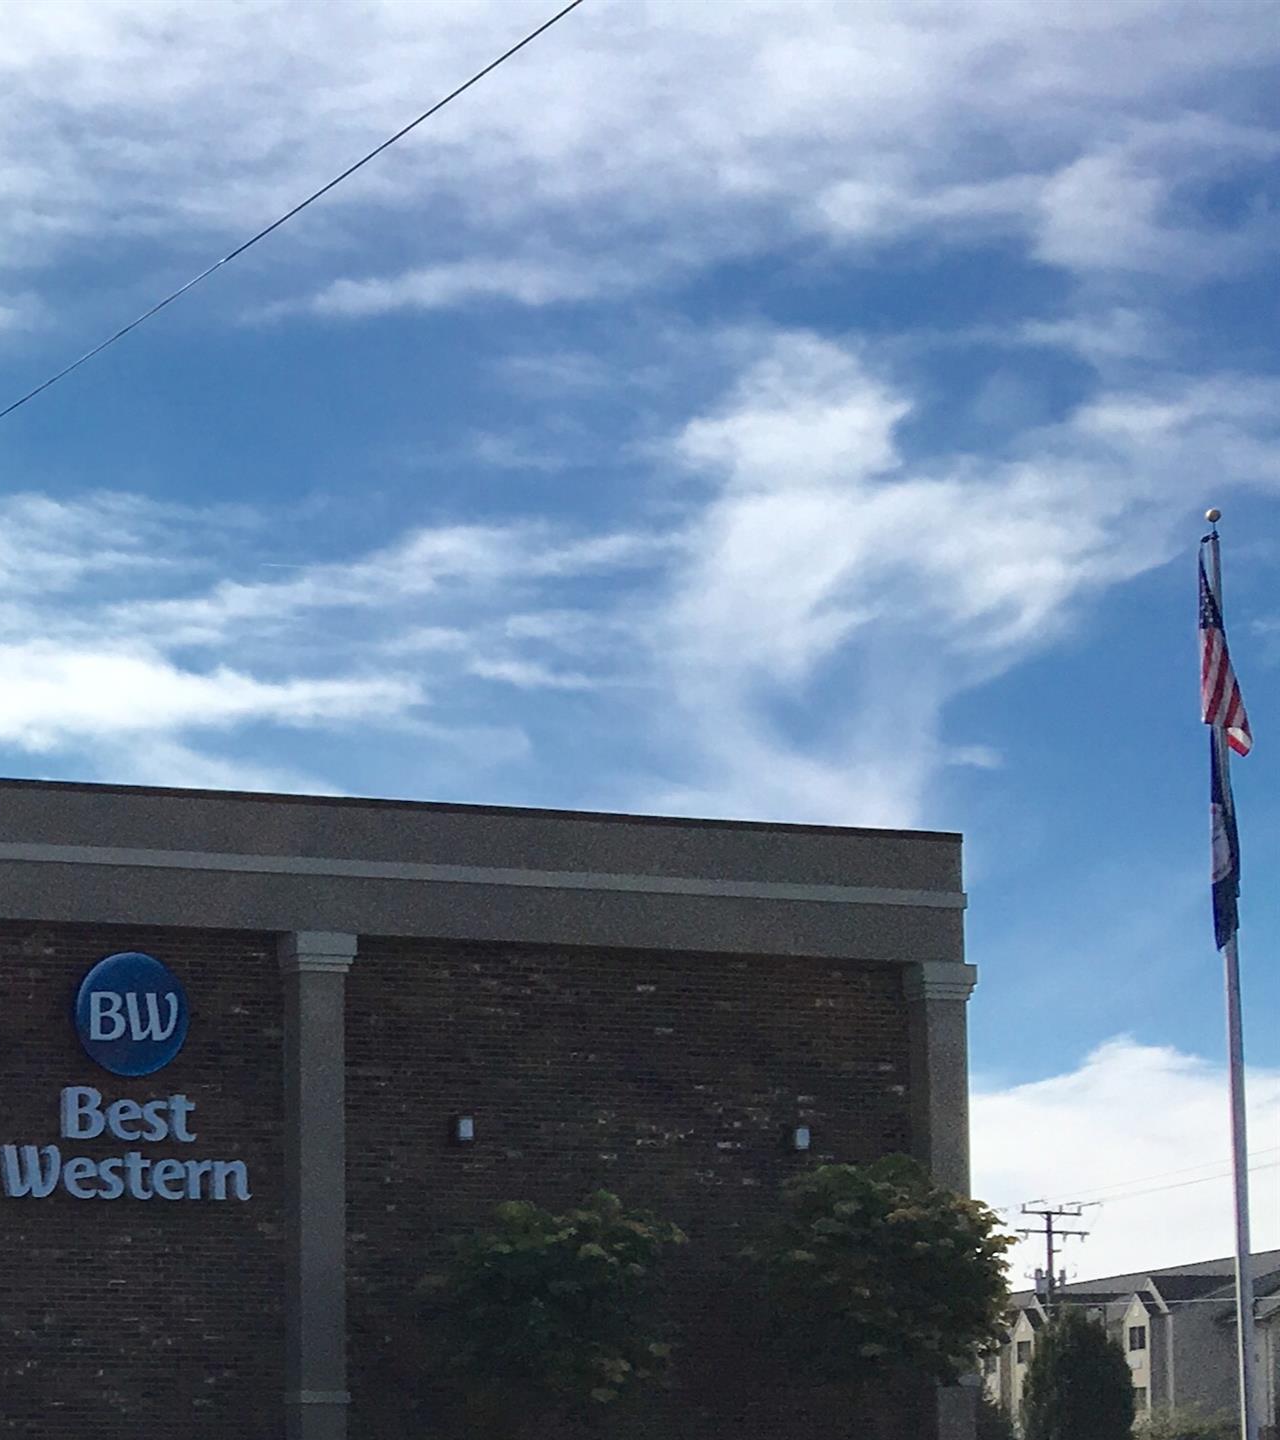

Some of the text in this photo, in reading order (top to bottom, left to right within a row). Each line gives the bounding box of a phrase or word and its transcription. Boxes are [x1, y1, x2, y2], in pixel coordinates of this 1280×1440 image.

[90, 990, 178, 1041] BW
[60, 1086, 197, 1142] Best
[0, 1144, 252, 1201] Western
